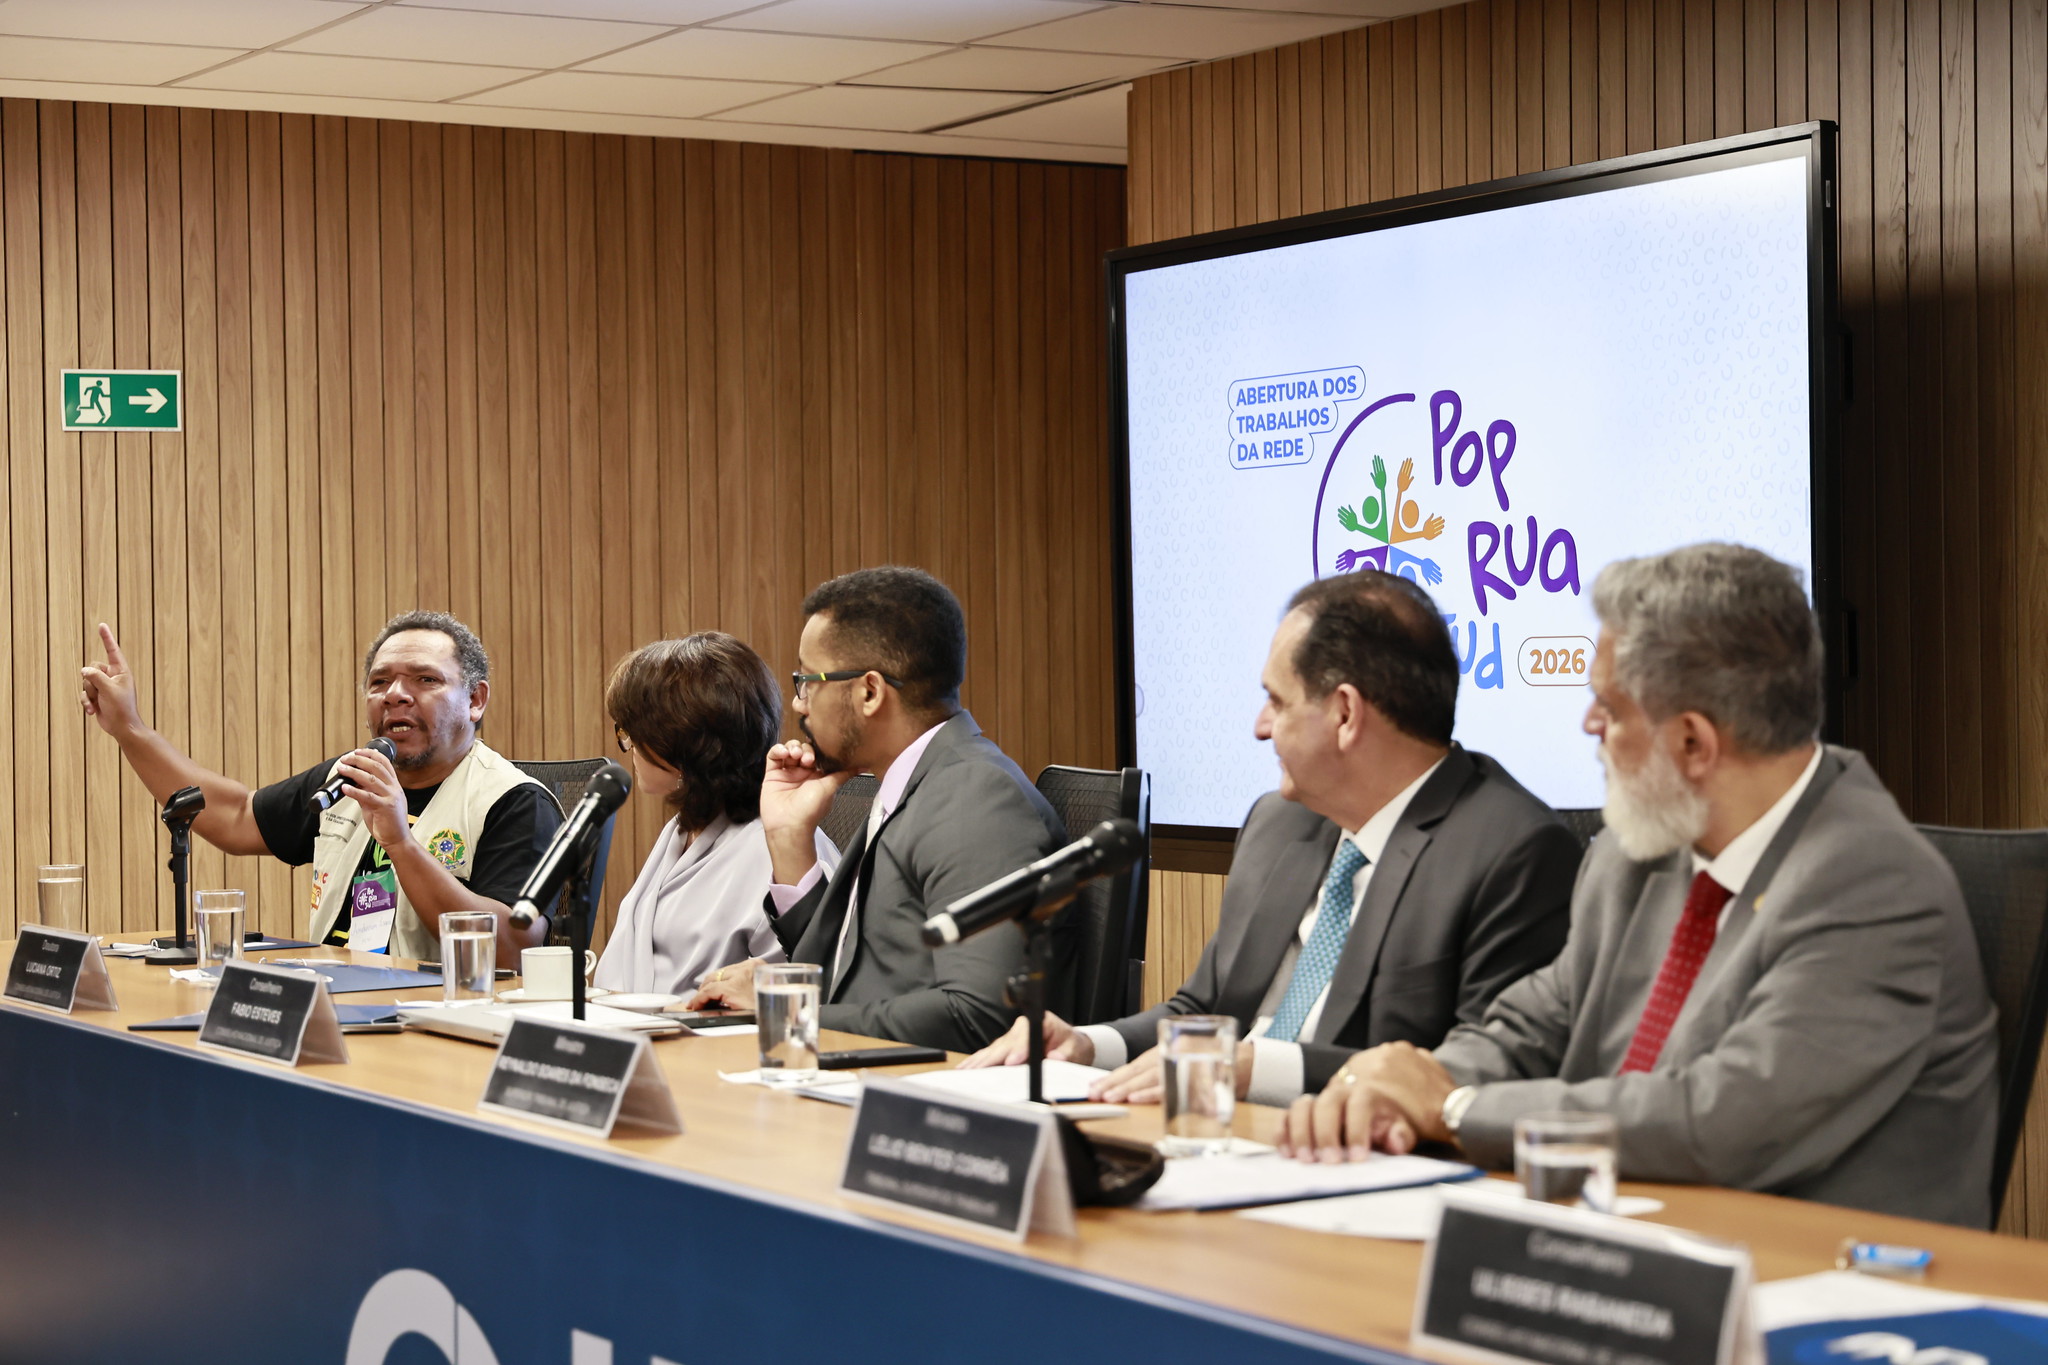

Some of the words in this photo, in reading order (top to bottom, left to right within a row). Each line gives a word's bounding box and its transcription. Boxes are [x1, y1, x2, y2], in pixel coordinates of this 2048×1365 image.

[1236, 380, 1319, 406] ABERTURA
[1323, 375, 1357, 396] DOS
[1236, 407, 1330, 434] TRABALHOS
[1237, 443, 1259, 461] DA
[1263, 438, 1304, 459] REDE
[1430, 390, 1517, 511] Pop
[1530, 648, 1586, 674] 2026
[251, 1006, 282, 1025] ESTEVES
